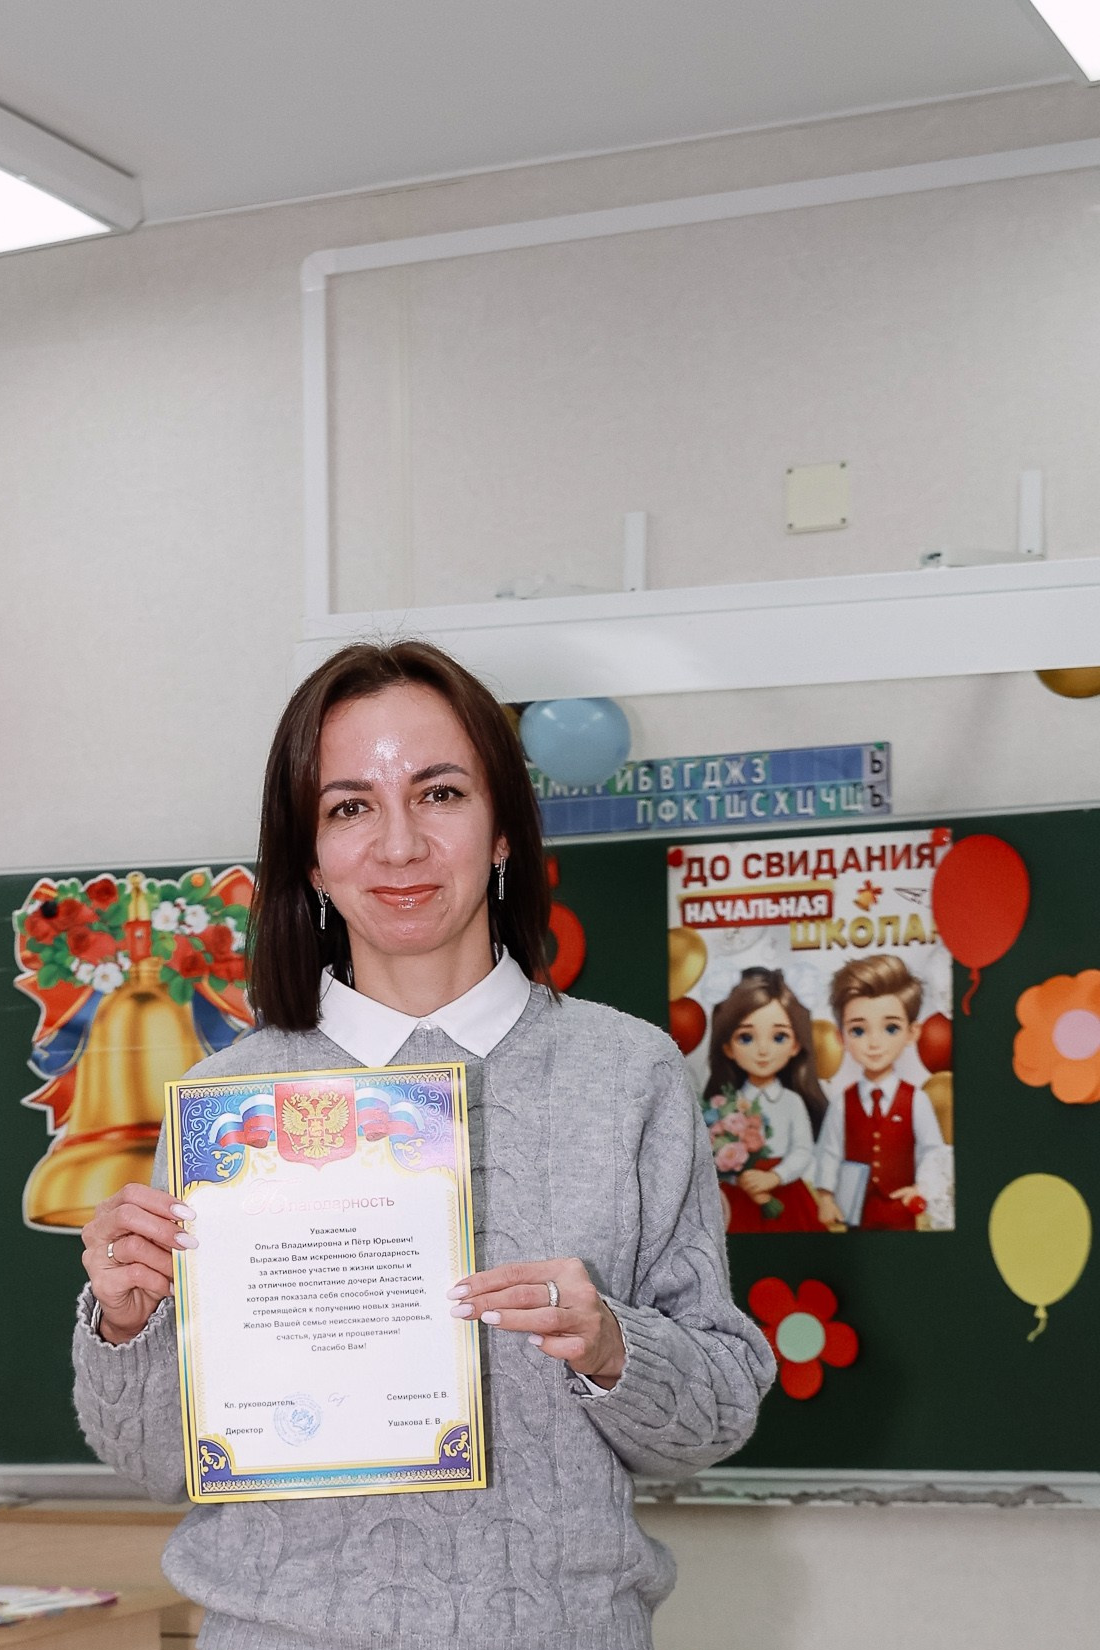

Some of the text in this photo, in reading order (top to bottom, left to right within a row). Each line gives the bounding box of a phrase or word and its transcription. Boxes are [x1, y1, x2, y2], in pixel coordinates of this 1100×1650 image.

[682, 842, 937, 888] ДО СВИДАНИЯ
[684, 893, 830, 924] НАЧАЛЬНАЯ
[309, 1227, 357, 1236] Уважаемые
[254, 1242, 280, 1251] Ольга
[280, 1240, 343, 1250] Владимировна
[351, 1237, 372, 1247] Пётр
[372, 1235, 414, 1246] Юрьевич!
[249, 1249, 420, 1265] Выражаю Вам искреннюю благодарность
[269, 1268, 307, 1276] активное
[308, 1266, 341, 1276] участие
[349, 1264, 375, 1272] жизни
[376, 1263, 405, 1271] школы
[257, 1281, 297, 1290] отличное
[298, 1279, 346, 1288] воспитание
[347, 1277, 378, 1286] дочери
[246, 1286, 427, 1304] которая показала себя способной ученицей,
[252, 1306, 308, 1317] стремящейся
[314, 1304, 361, 1314] получению
[362, 1303, 390, 1311] новых
[242, 1321, 273, 1330] Желаю
[273, 1319, 301, 1328] Вашей
[302, 1319, 328, 1327] семье
[391, 1314, 433, 1323] здоровья,
[275, 1333, 311, 1341] счастья,
[312, 1332, 337, 1341] удачи
[345, 1327, 401, 1339] процветания!
[310, 1342, 367, 1353] Спасибо Вам!
[223, 1399, 296, 1410] Кл. руководитель
[387, 1419, 424, 1428] Ушакова
[224, 1427, 264, 1438] Директор
